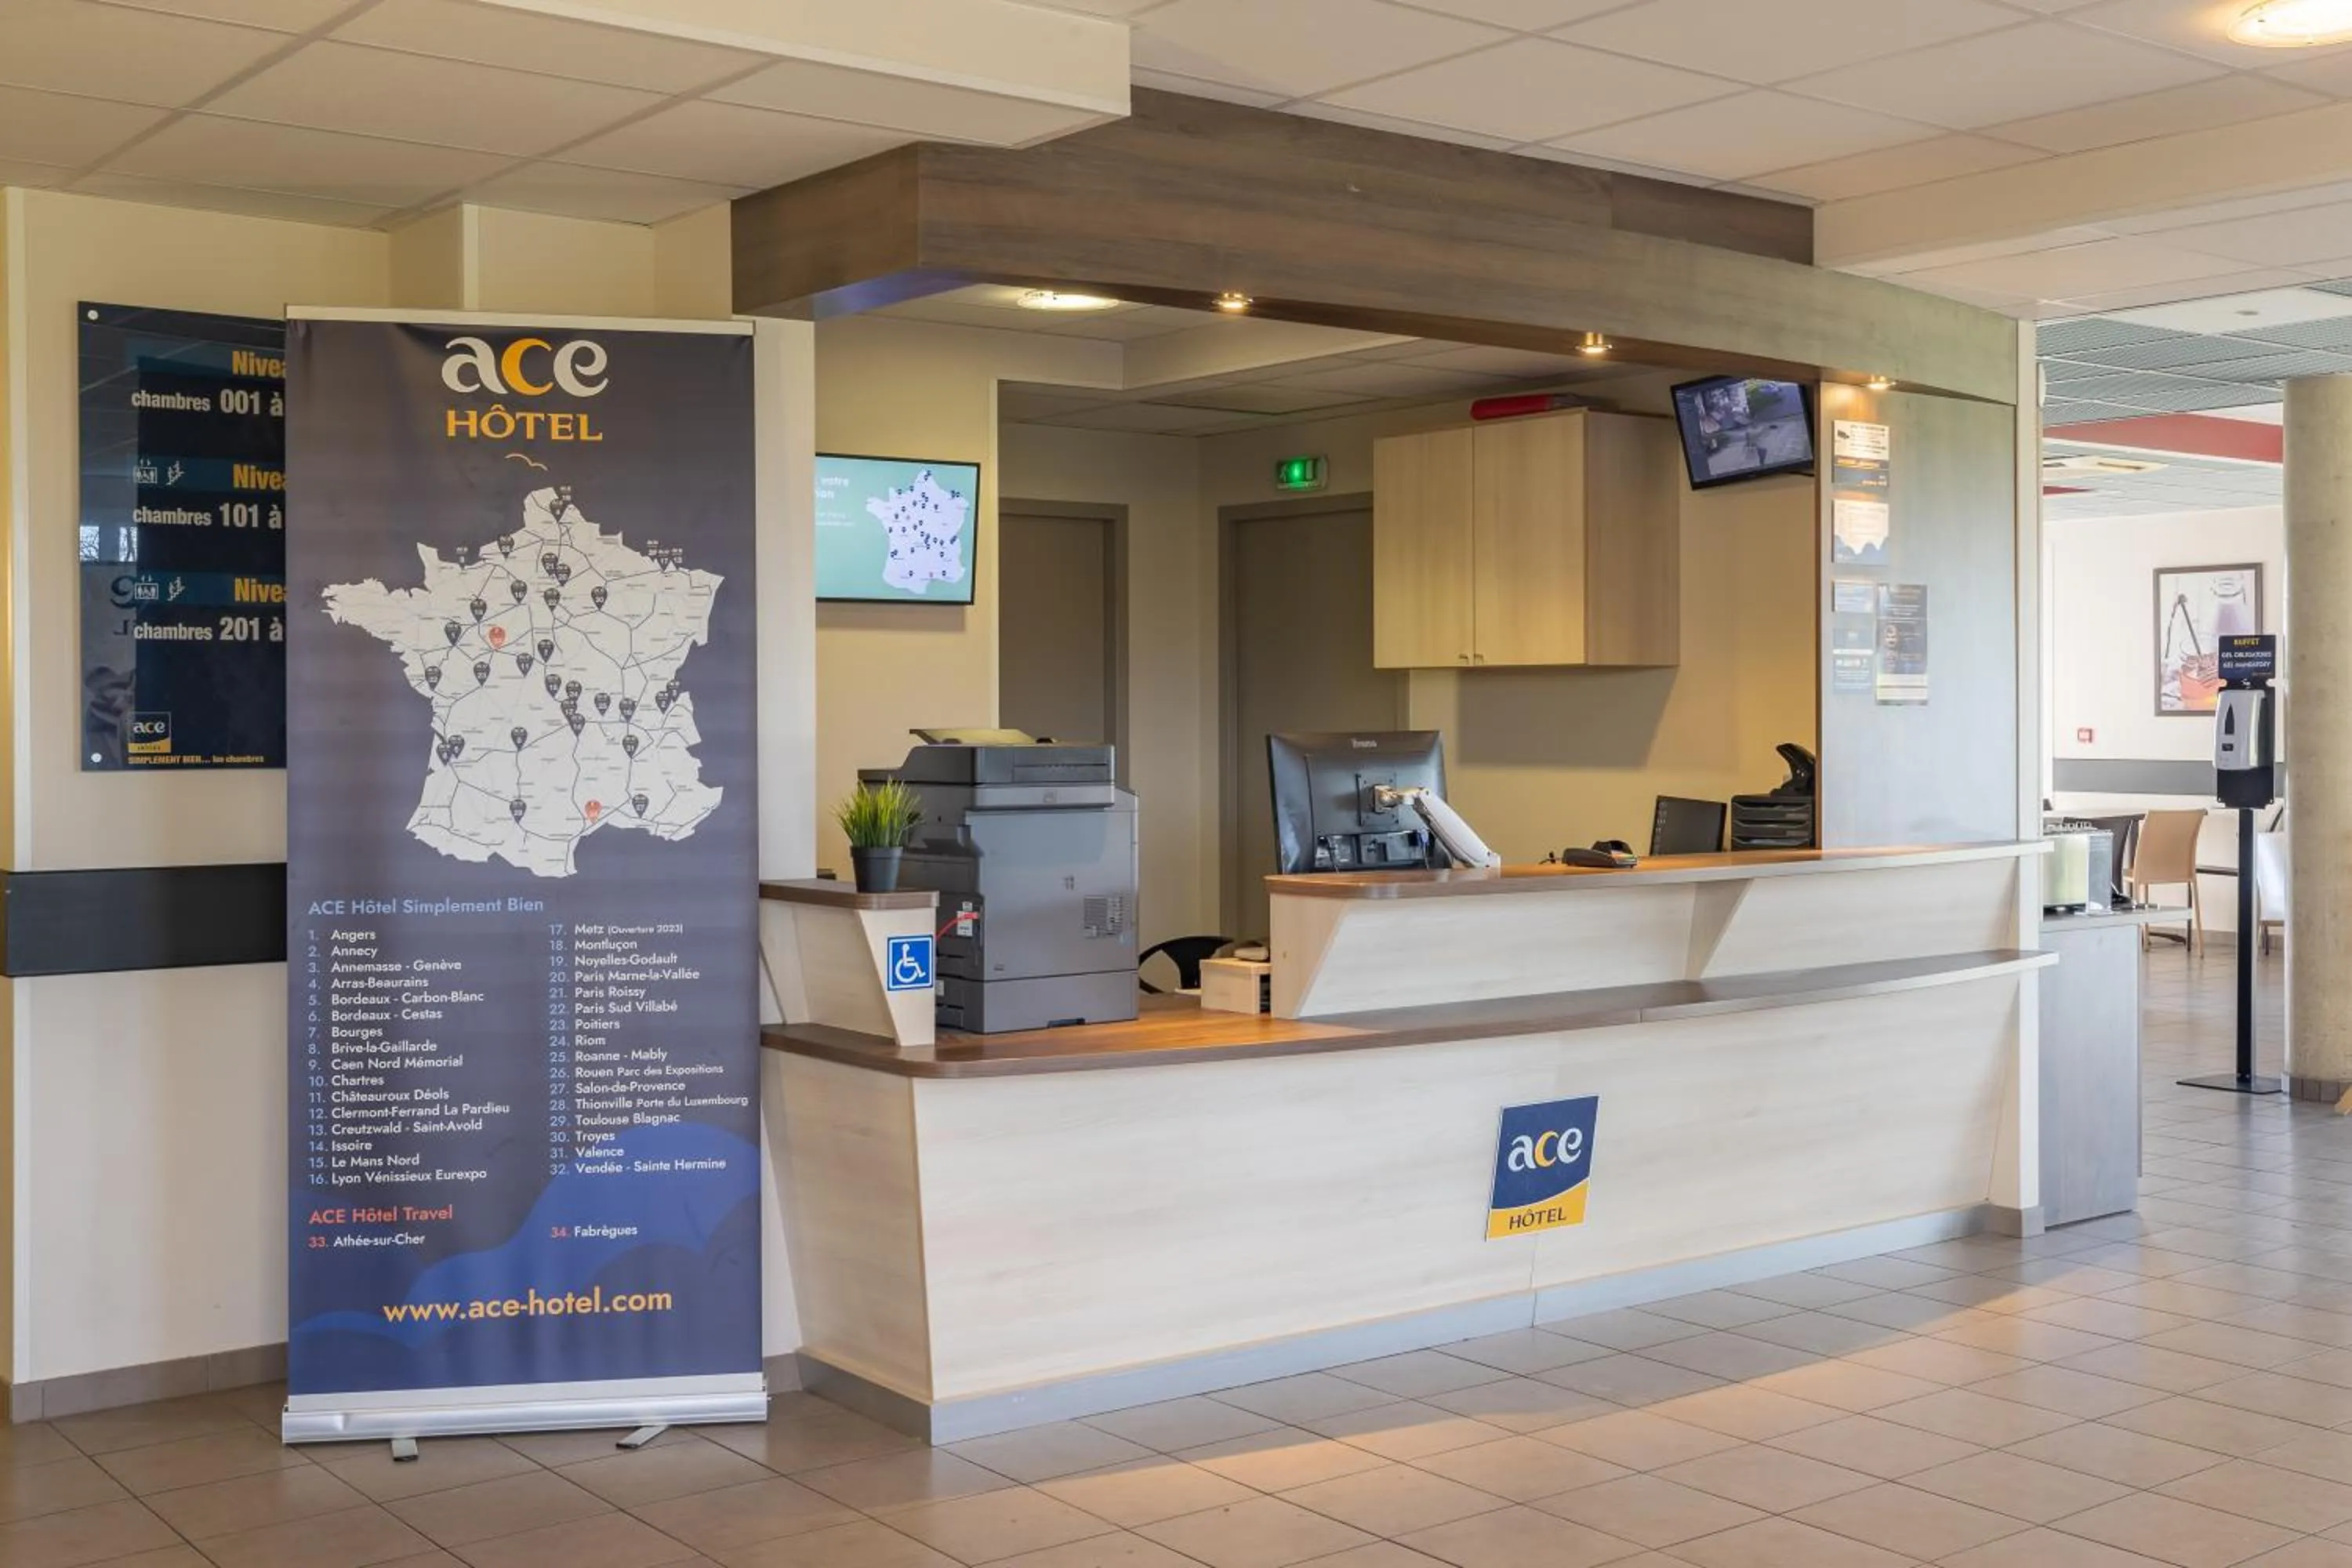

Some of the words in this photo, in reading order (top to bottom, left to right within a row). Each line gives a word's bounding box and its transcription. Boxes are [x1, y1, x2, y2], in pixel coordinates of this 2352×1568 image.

[441, 336, 609, 397] ace
[131, 390, 211, 412] chambres
[220, 388, 260, 415] 001
[269, 393, 283, 416] à
[447, 404, 602, 441] HÔTEL
[233, 463, 286, 490] Nive
[132, 506, 212, 526] chambres
[220, 503, 259, 528] 101
[268, 504, 282, 529] à
[234, 576, 286, 603] Nive
[133, 622, 213, 641] chambres
[220, 615, 260, 641] 201
[269, 616, 283, 641] à
[133, 721, 165, 734] ace
[309, 901, 344, 915] ACE
[353, 899, 396, 914] Hôtel
[403, 898, 502, 916] Simplement
[508, 898, 543, 911] Bien
[331, 930, 376, 942] Angers
[549, 924, 567, 935] 17.
[575, 924, 604, 935] Metz
[309, 946, 321, 957] 2.
[331, 946, 378, 958] Annecy
[550, 941, 567, 951] 18.
[575, 938, 637, 952] Montluçon
[308, 962, 321, 973] 3.
[331, 962, 401, 973] Annemasse
[413, 960, 462, 971] Genève
[550, 956, 568, 967] 19.
[550, 971, 569, 982] 20.
[575, 971, 604, 982] Paris
[608, 969, 700, 982] Marne-la-Vallée
[308, 978, 321, 989] 4.
[331, 977, 429, 989] Arras-Beaurains
[308, 994, 321, 1006] 5.
[332, 993, 390, 1005] Bordeaux
[401, 991, 485, 1004] Carbon-Blanc
[550, 988, 567, 998] 21.
[575, 987, 604, 998] Paris
[608, 986, 646, 999] Roissy
[550, 1004, 569, 1014] 22.
[575, 1003, 604, 1014] Paris
[608, 1002, 631, 1013] Sud
[636, 1000, 677, 1012] Villabé
[308, 1011, 321, 1022] 6.
[332, 1011, 390, 1022] Bordeaux
[401, 1009, 442, 1020] Cestas
[550, 1019, 568, 1030] 23.
[575, 1019, 620, 1029] Poitiers
[309, 1027, 320, 1039] 7.
[332, 1027, 383, 1040] Bourges
[308, 1044, 321, 1054] 8.
[332, 1040, 437, 1054] Brive-la-Gaillarde
[550, 1036, 569, 1047] 24.
[575, 1035, 606, 1046] Riom
[550, 1051, 569, 1062] 25.
[575, 1051, 620, 1062] Roanne
[631, 1048, 668, 1062] Mably
[308, 1060, 321, 1071] 9.
[332, 1059, 363, 1070] Caen
[368, 1058, 400, 1069] Nord
[405, 1054, 463, 1068] Mémorial
[550, 1068, 570, 1079] 26.
[575, 1067, 613, 1078] Rouen
[617, 1067, 640, 1077] Parc
[644, 1065, 662, 1075] des
[666, 1065, 724, 1076] Expositions
[309, 1076, 328, 1087] 10.
[332, 1075, 384, 1086] Chartres
[550, 1083, 569, 1094] 27.
[575, 1081, 686, 1094] Salon-de-Provence
[309, 1093, 326, 1103] 11.
[332, 1091, 409, 1102] Châteauroux
[414, 1087, 449, 1100] Déols
[550, 1100, 570, 1111] 28.
[575, 1097, 633, 1109] Thionville
[637, 1098, 664, 1108] Porte
[667, 1097, 681, 1107] du
[685, 1095, 749, 1107] Luxembourg
[309, 1109, 328, 1120] 12.
[332, 1105, 440, 1119] Clermont-Ferrand
[445, 1105, 458, 1115] La
[462, 1103, 510, 1114] Pardieu
[550, 1116, 570, 1127] 29.
[575, 1114, 629, 1126] Toulouse
[633, 1113, 681, 1127] Blagnac
[309, 1125, 327, 1136] 13.
[332, 1121, 401, 1135] Creutzwald
[413, 1119, 482, 1133] Saint-Avold
[550, 1131, 570, 1142] 30.
[575, 1131, 615, 1144] Troyes
[309, 1142, 328, 1152] 14.
[332, 1141, 372, 1151] Issoire
[550, 1148, 568, 1159] 31.
[575, 1146, 624, 1157] Valence
[1507, 1127, 1583, 1172] ace
[309, 1157, 327, 1168] 15.
[332, 1156, 347, 1167] Le
[350, 1156, 383, 1167] Mans
[387, 1154, 419, 1166] Nord
[550, 1164, 569, 1175] 32.
[575, 1163, 623, 1174] Vendée
[633, 1160, 670, 1172] Sainte
[675, 1159, 726, 1171] Hermine
[309, 1174, 328, 1185] 16.
[332, 1173, 361, 1186] Lyon
[365, 1171, 431, 1182] Vénissieux
[436, 1169, 487, 1183] Eurexpo
[309, 1209, 347, 1224] ACE
[353, 1206, 397, 1223] Hôtel
[403, 1205, 452, 1221] Travel
[1509, 1207, 1567, 1230] HÔTEL
[575, 1225, 637, 1239] Fabrègues
[308, 1236, 328, 1248] 33.
[333, 1233, 425, 1247] Athée-sur-Cher
[383, 1286, 673, 1322] www.ace-hotel.com
